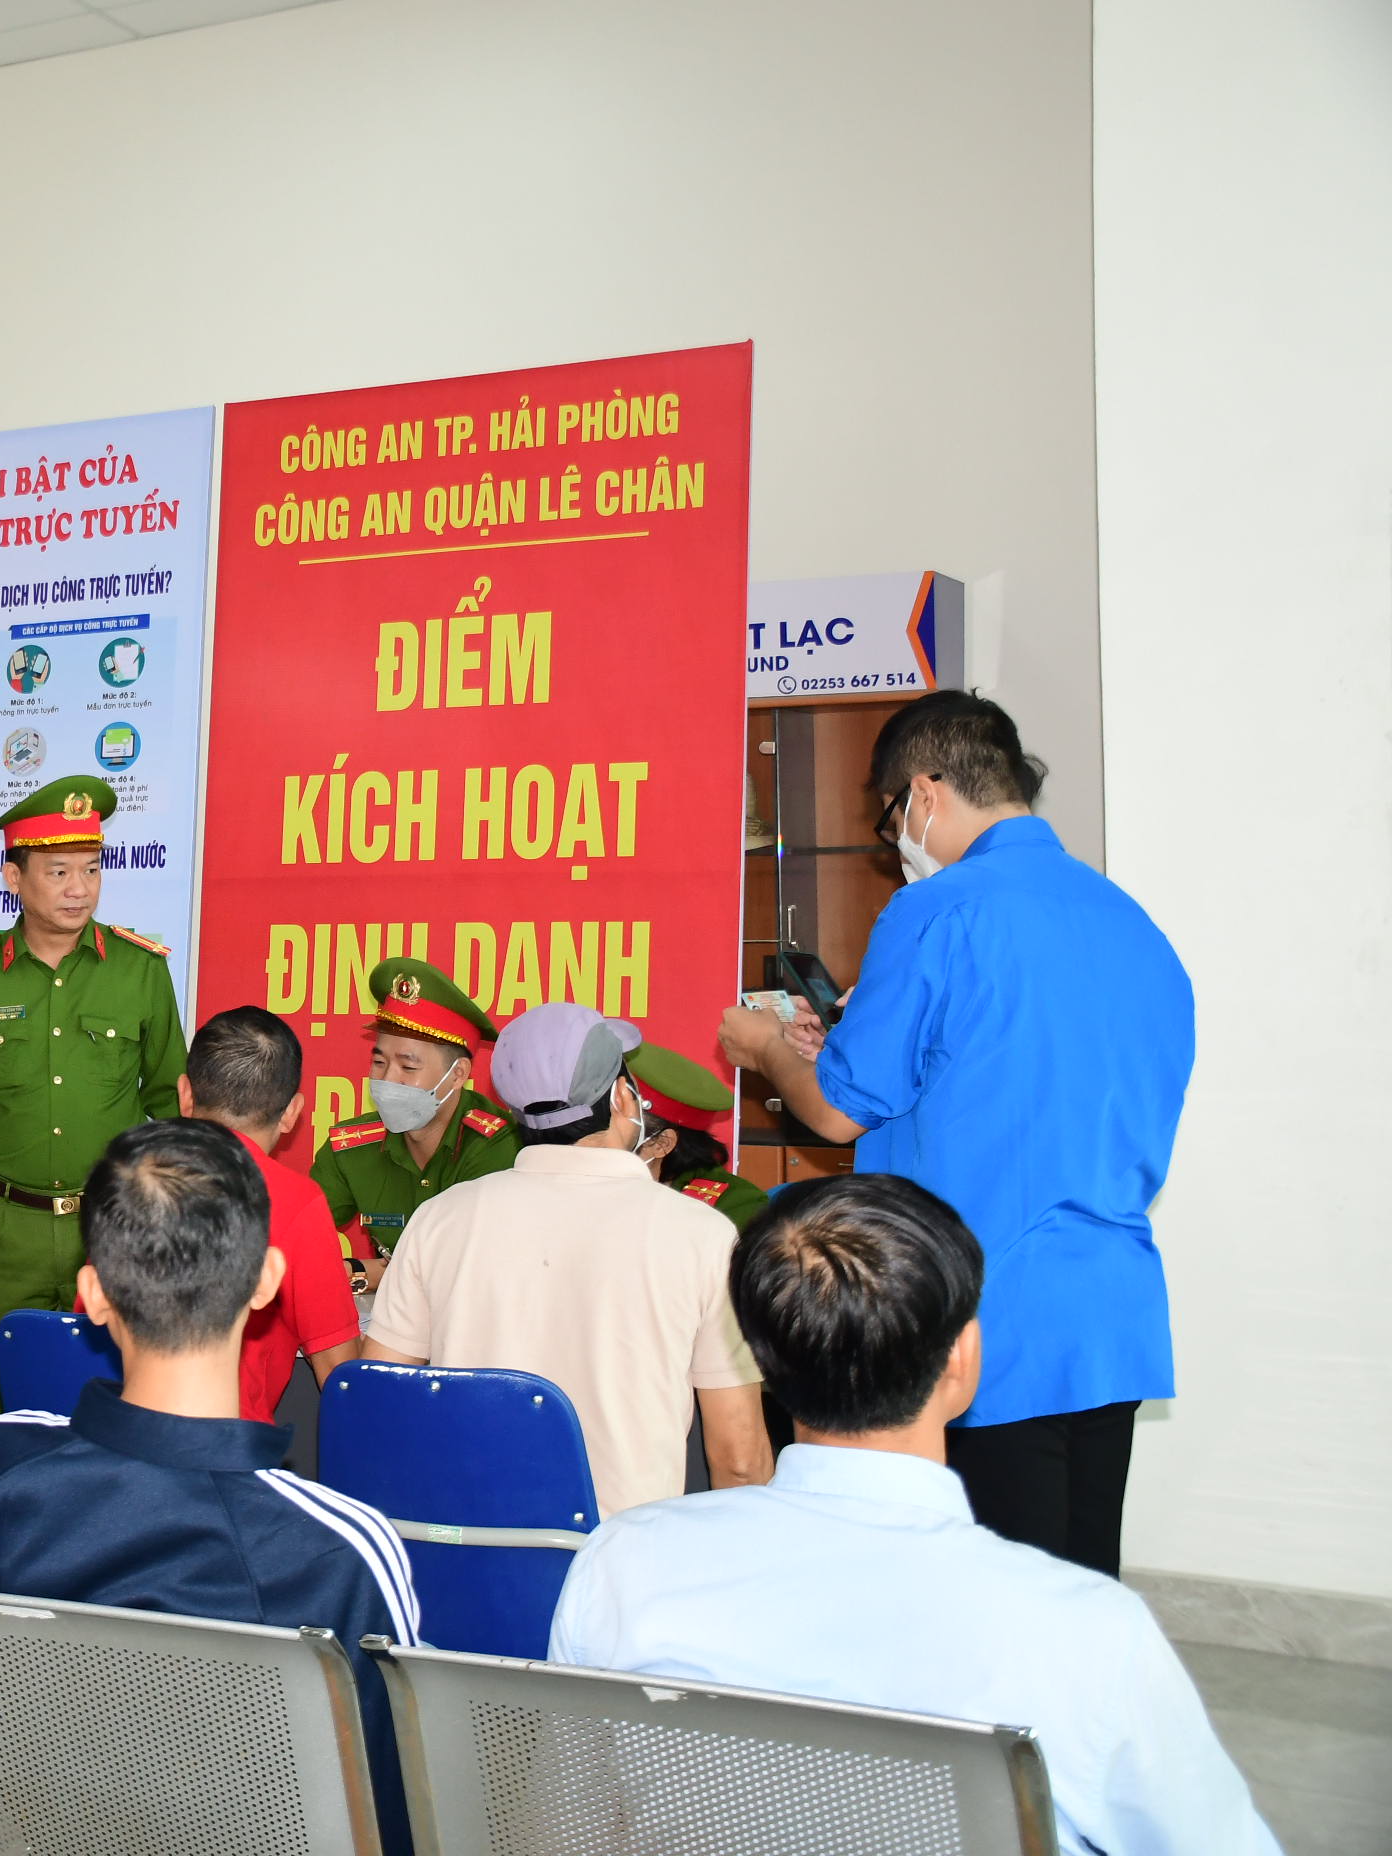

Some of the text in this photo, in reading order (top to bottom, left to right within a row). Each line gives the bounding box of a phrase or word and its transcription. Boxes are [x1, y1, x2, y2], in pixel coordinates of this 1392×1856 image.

[280, 388, 679, 474] CÔNG AN TP. HẢI PHÒNG
[14, 455, 72, 502] BẬT
[78, 444, 139, 489] CỦA
[80, 488, 181, 539] TUYẾN
[254, 456, 705, 547] CÔNG AN QUẬN LÊ CHÂN
[1, 583, 29, 613] DỊCH
[33, 581, 49, 609] VỤ
[51, 575, 85, 604] CÔNG
[88, 572, 121, 604] TRỰC
[124, 564, 173, 599] TUYẾN?
[375, 576, 552, 712] ĐIỂM
[748, 618, 855, 655] T LẠC
[748, 656, 789, 672] UND
[801, 672, 916, 690] 02253 667 514
[281, 753, 648, 881] KÍCH HOẠT
[101, 841, 126, 870] NHÀ
[130, 839, 167, 869] NƯỚC
[454, 921, 650, 1018] DANH
